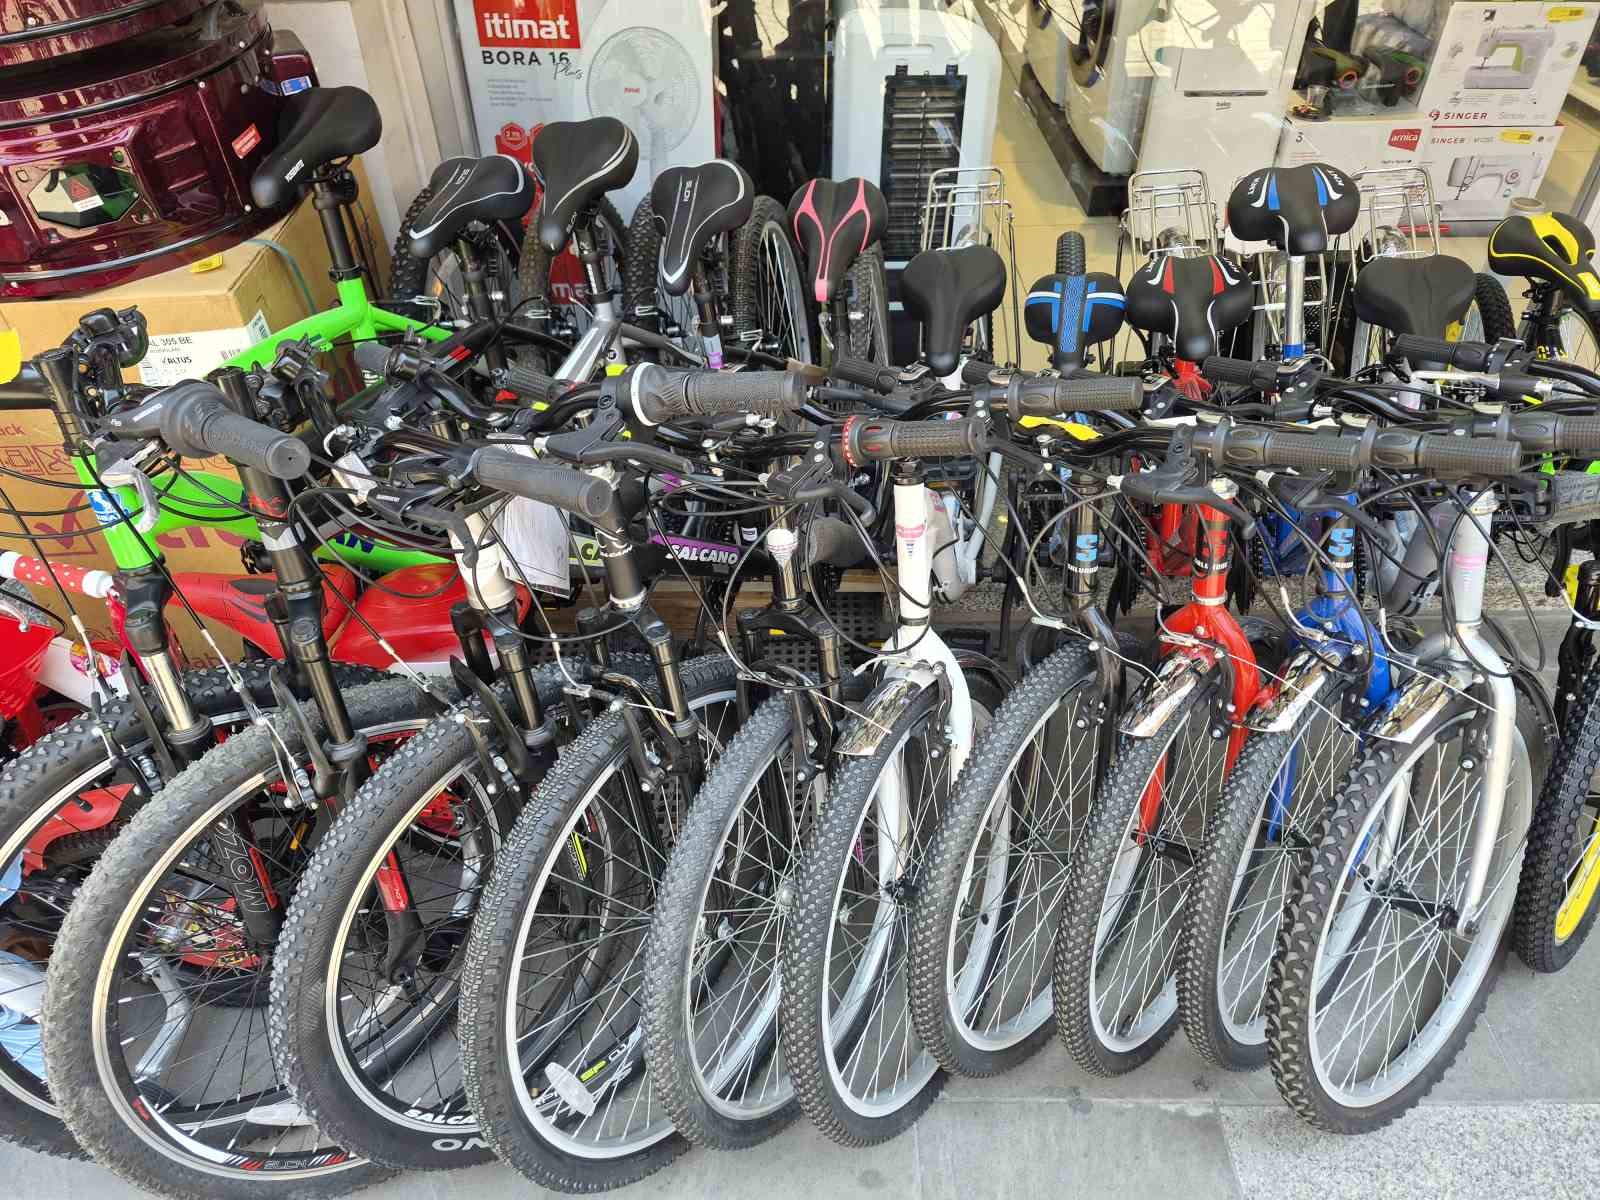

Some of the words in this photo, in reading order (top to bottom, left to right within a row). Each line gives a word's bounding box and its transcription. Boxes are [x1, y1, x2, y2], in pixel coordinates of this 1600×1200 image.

[483, 12, 571, 40] itimat
[482, 50, 542, 66] BORA
[549, 51, 570, 65] 16
[1443, 112, 1488, 120] SINGER
[1390, 134, 1419, 142] arnica
[1431, 137, 1466, 145] SINGER
[167, 355, 193, 364] ALTUS
[664, 543, 739, 566] SALCANO
